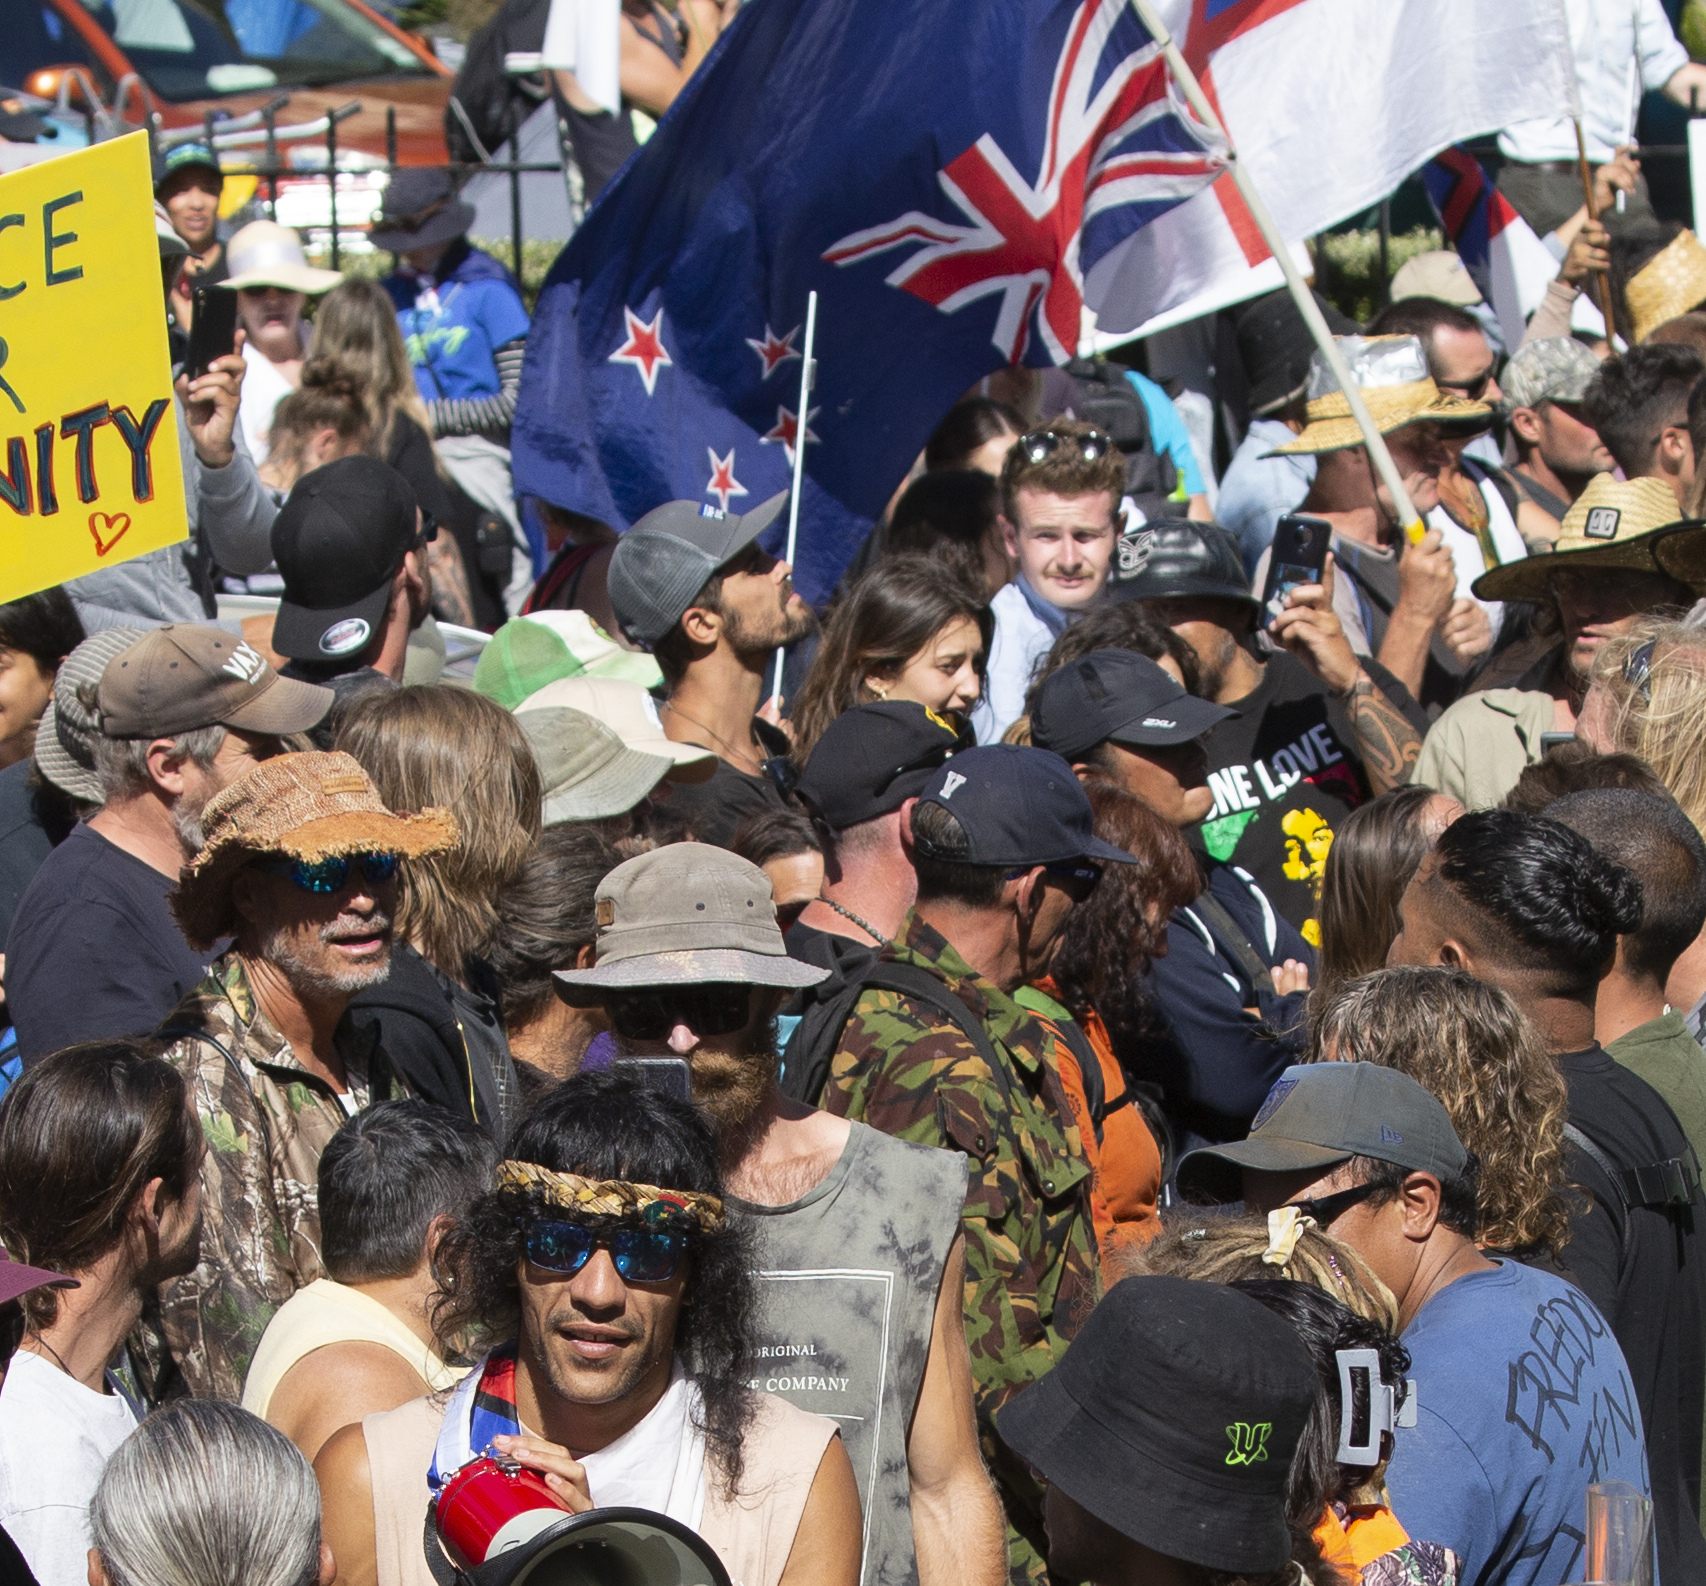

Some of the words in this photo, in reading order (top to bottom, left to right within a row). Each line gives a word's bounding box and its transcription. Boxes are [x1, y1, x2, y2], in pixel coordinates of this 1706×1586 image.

[221, 639, 260, 680] VAX
[1253, 722, 1343, 801] LOVE
[765, 1375, 851, 1393] COMPANY
[1505, 1286, 1611, 1466] FREEDO
